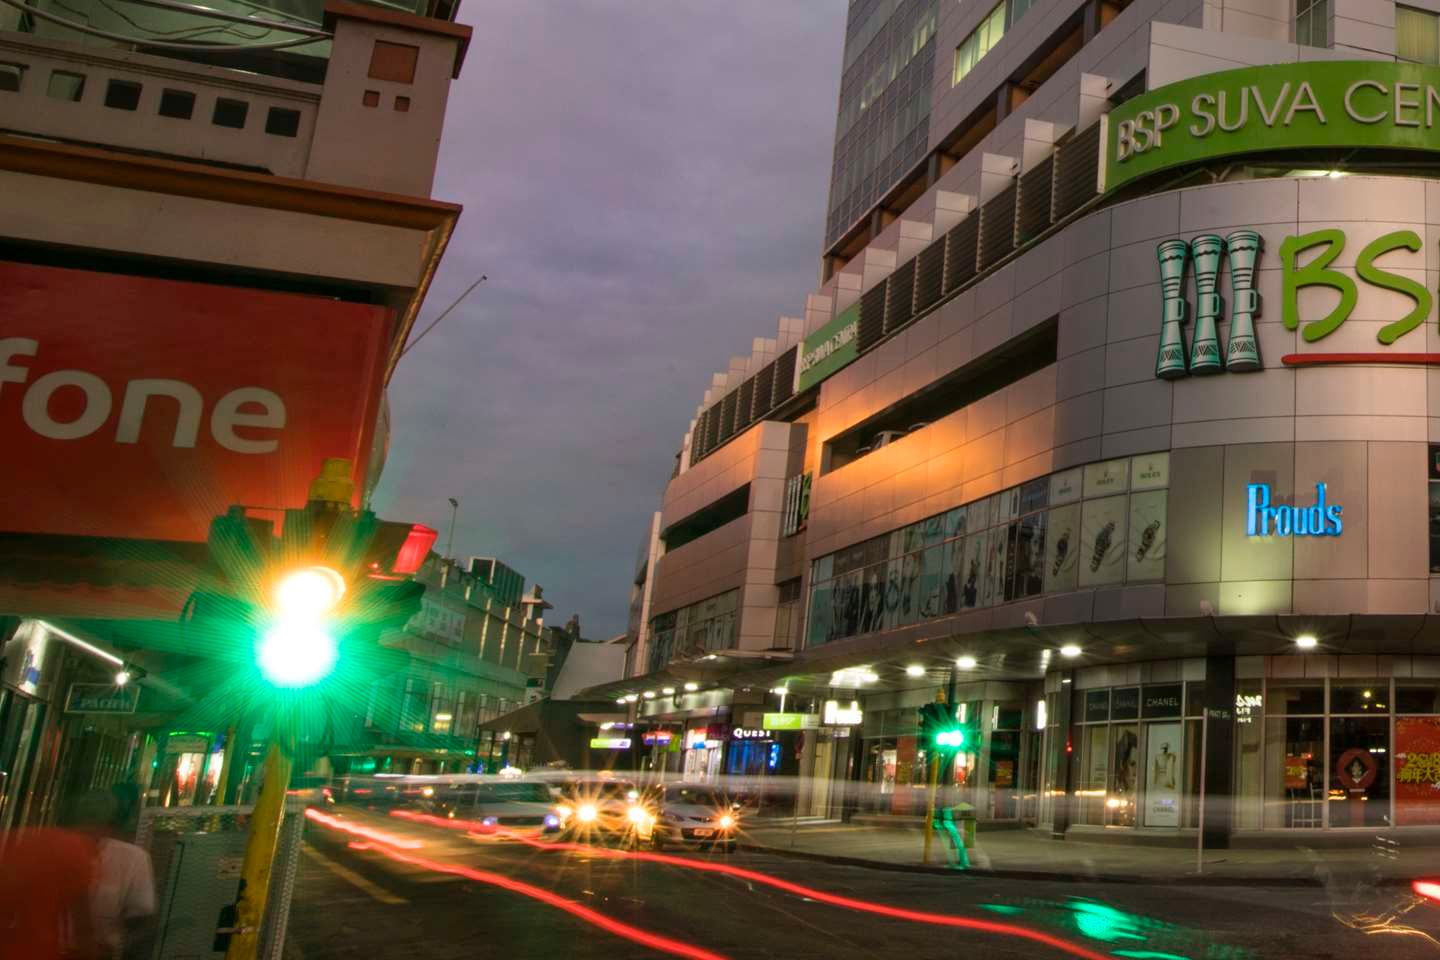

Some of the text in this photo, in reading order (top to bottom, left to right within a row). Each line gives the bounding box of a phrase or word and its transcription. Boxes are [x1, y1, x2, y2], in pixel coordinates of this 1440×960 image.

[1116, 102, 1180, 163] BSP
[1190, 80, 1328, 138] SUVA
[1247, 481, 1344, 536] Prouds
[1145, 697, 1180, 708] CHANEL
